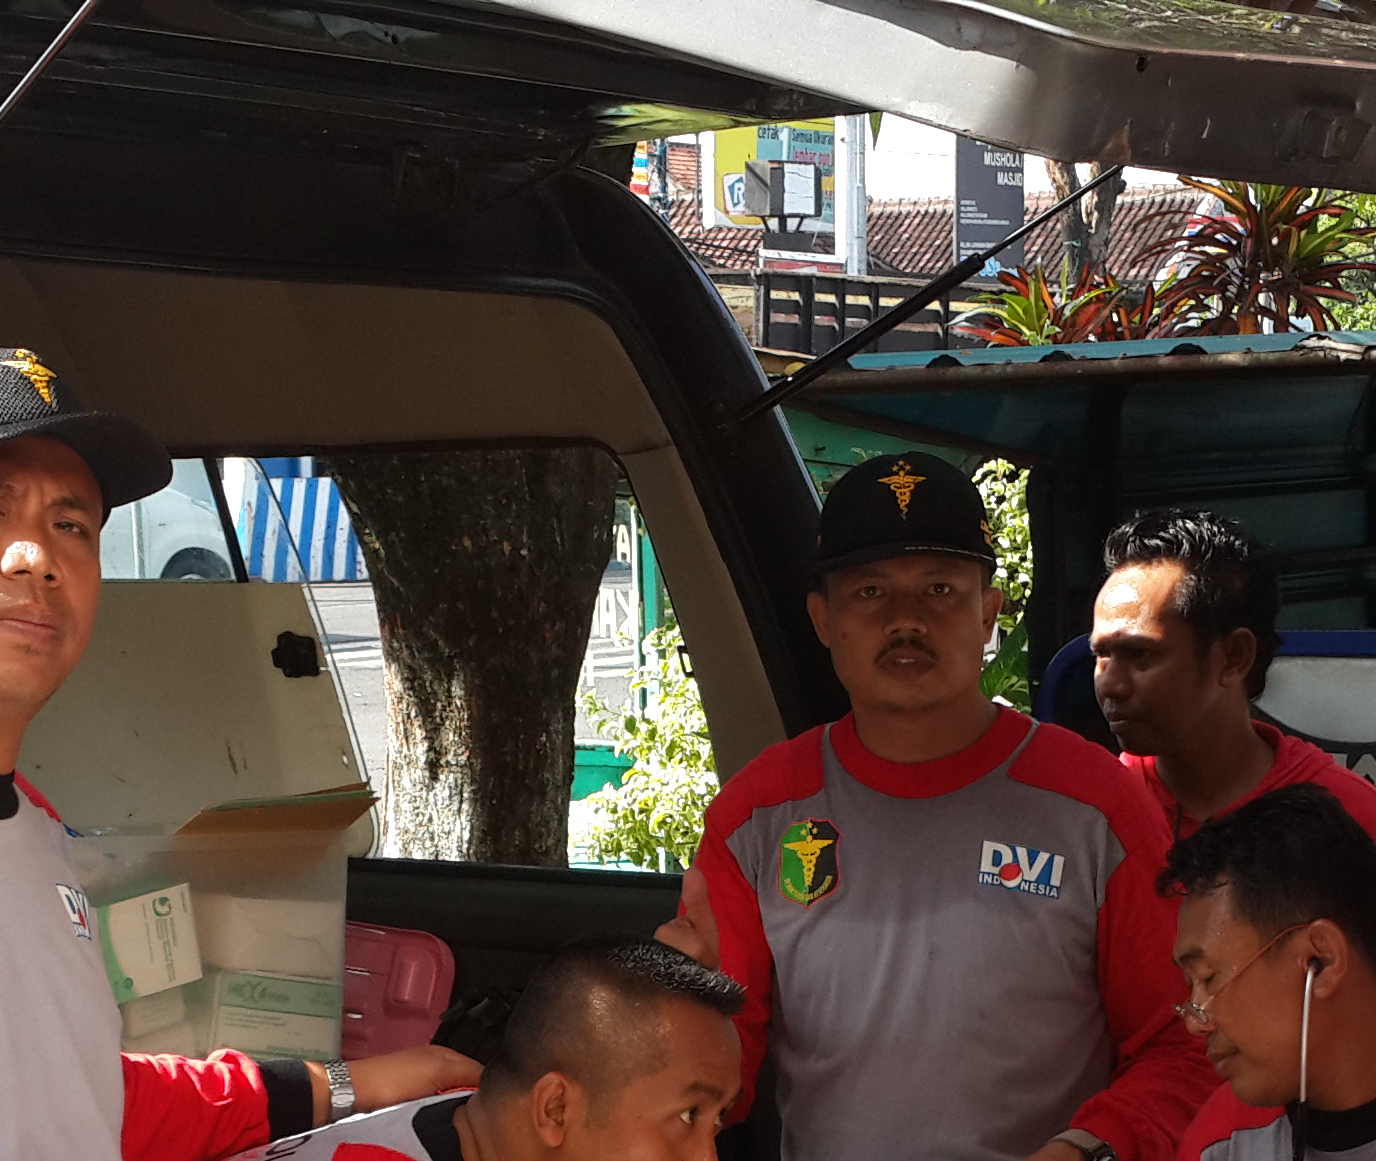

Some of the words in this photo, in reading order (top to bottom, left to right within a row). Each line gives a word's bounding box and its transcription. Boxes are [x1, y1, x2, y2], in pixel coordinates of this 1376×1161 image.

[984, 151, 1020, 168] MUSHOLA
[997, 171, 1023, 187] MASJID
[980, 840, 1065, 888] DVI
